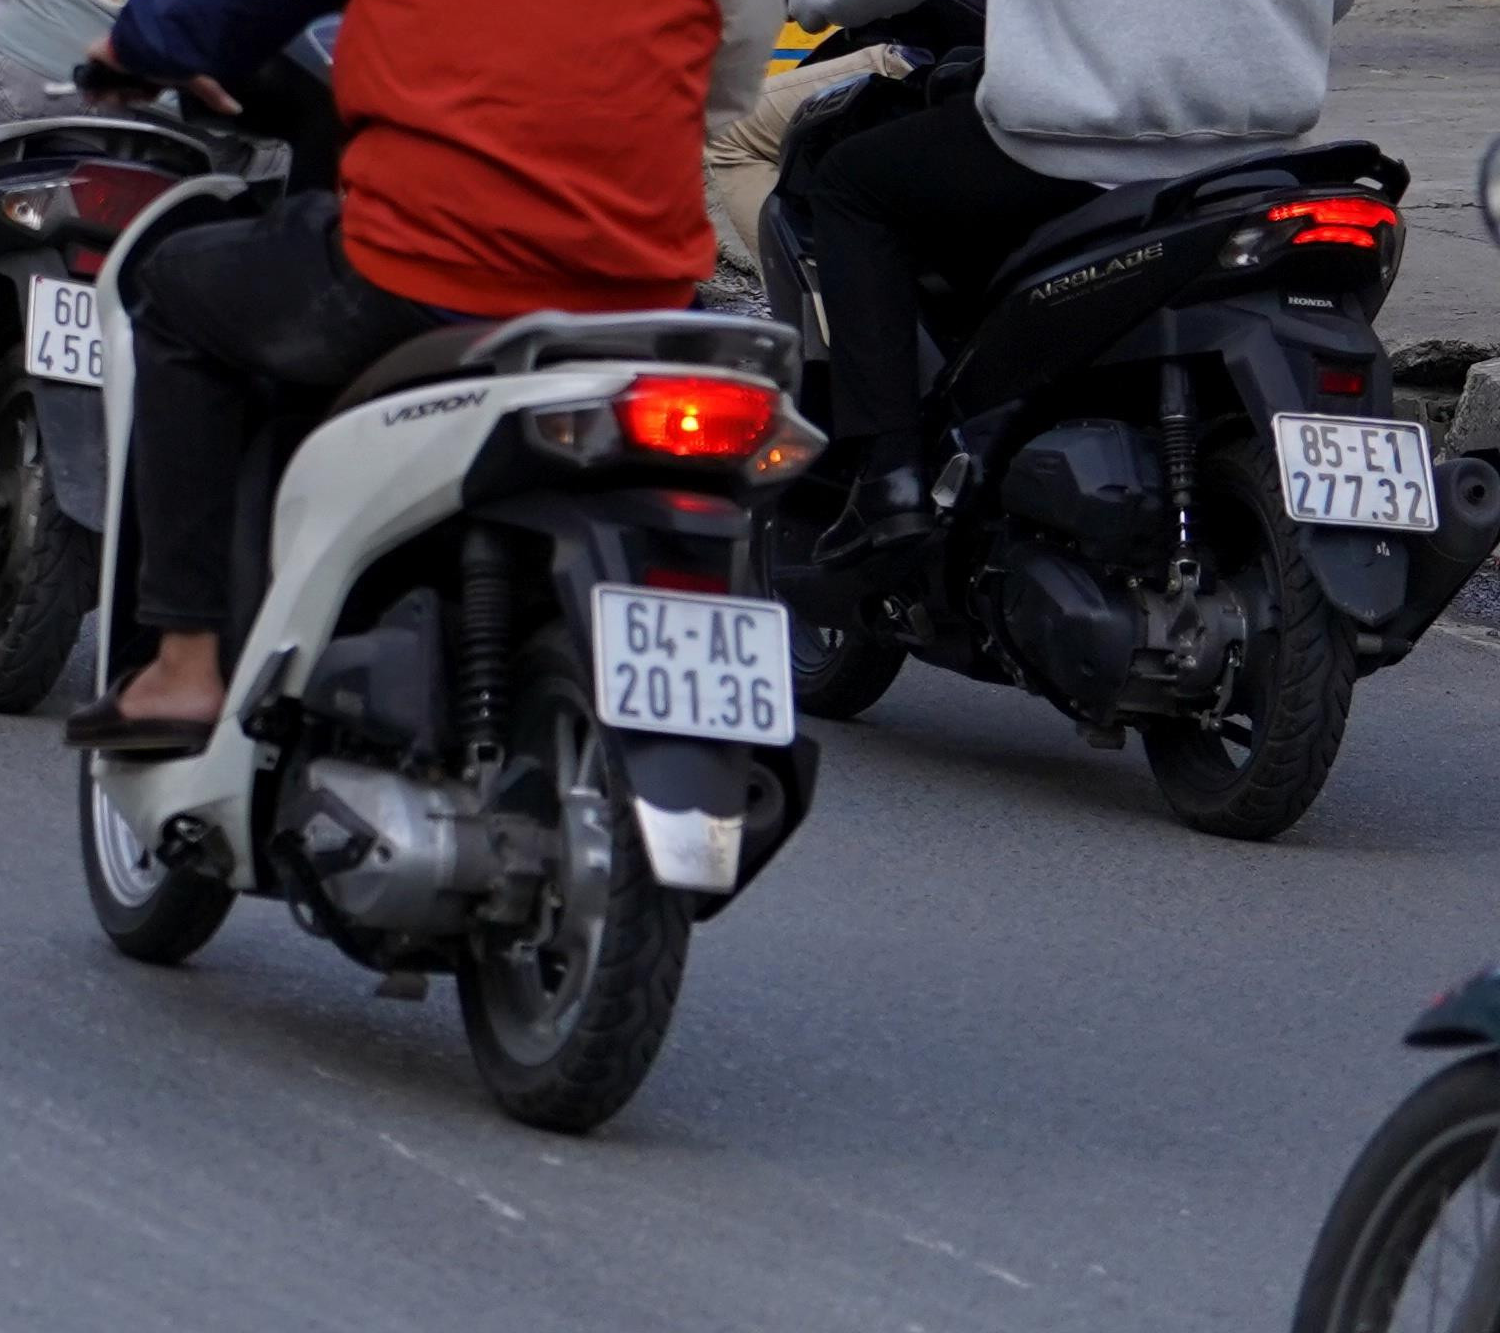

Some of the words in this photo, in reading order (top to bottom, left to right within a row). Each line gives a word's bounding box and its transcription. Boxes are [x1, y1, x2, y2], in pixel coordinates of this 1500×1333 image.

[1287, 295, 1334, 309] HONDA
[383, 387, 491, 428] VISION
[1300, 425, 1404, 476] 85-E1
[1293, 471, 1427, 527] 277.32
[625, 602, 759, 667] 64-AC
[616, 662, 774, 731] 201.36
